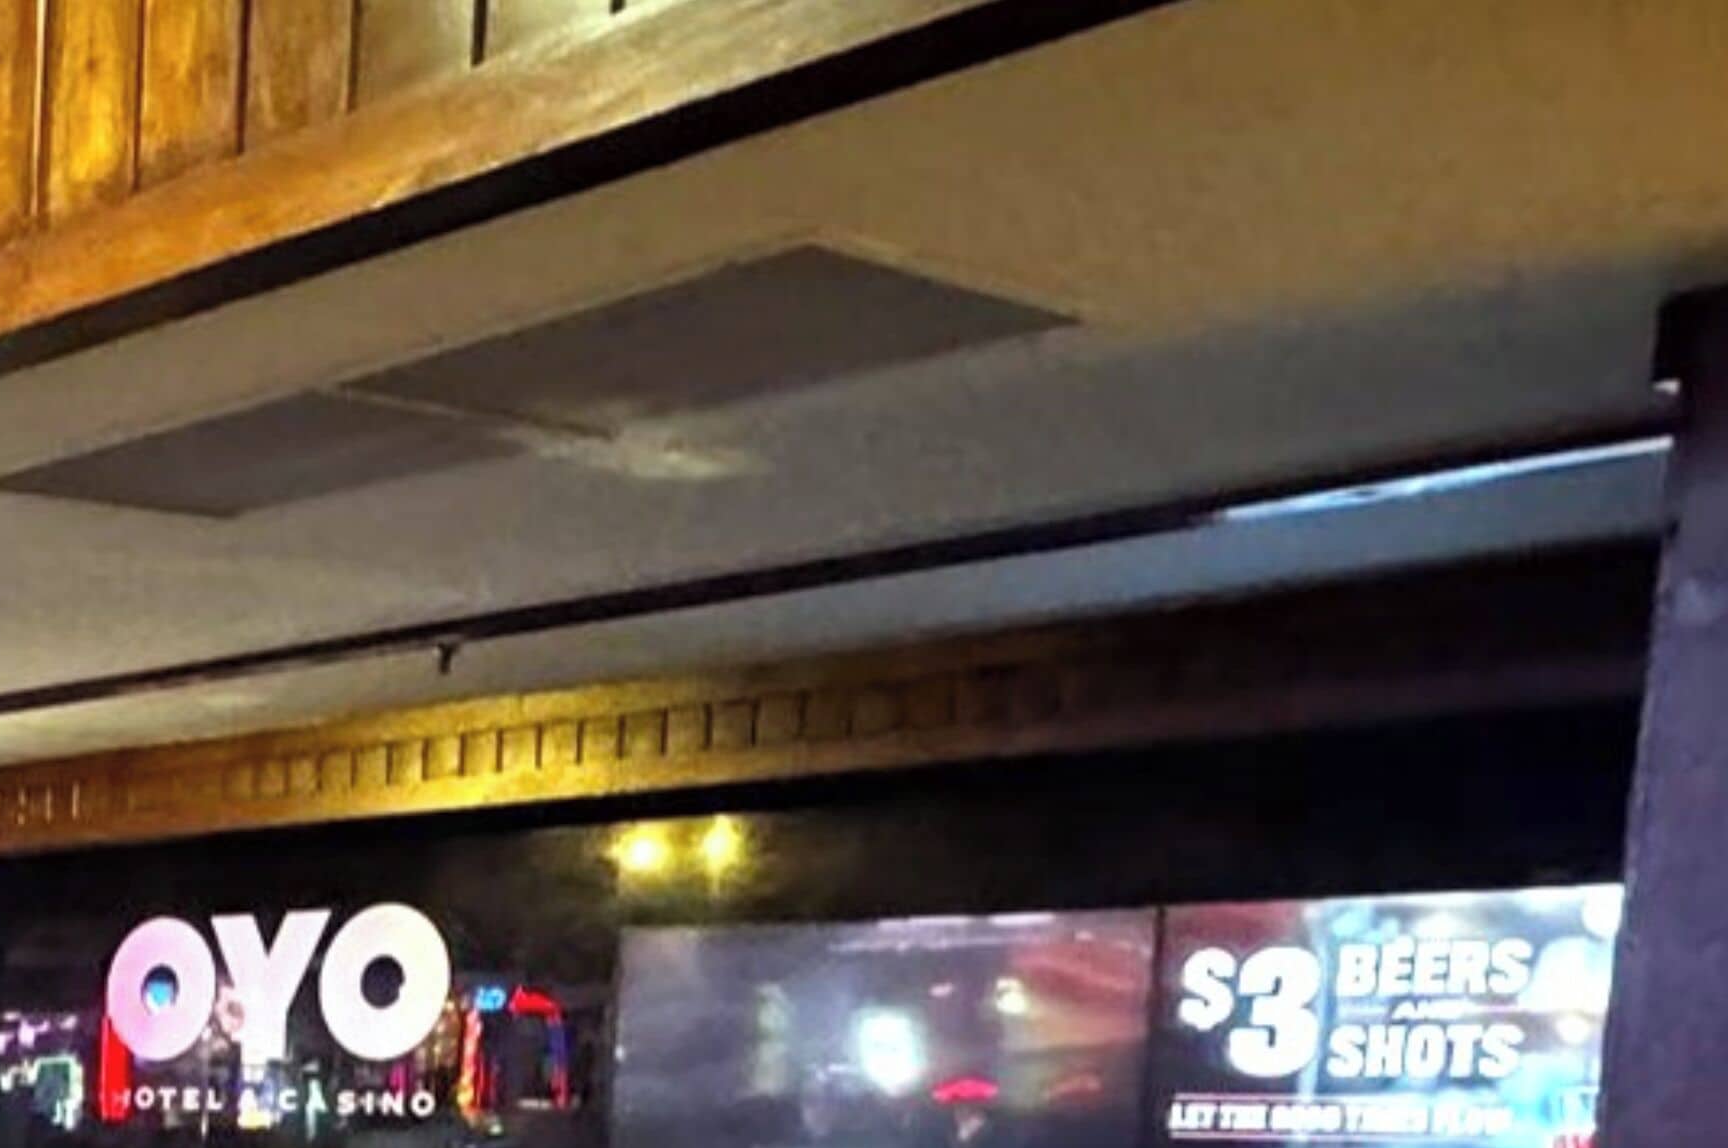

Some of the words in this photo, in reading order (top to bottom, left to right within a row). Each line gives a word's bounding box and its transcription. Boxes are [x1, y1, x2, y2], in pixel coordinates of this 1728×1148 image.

[106, 902, 452, 1062] OYO
[1336, 938, 1532, 998] BEERS
[1178, 946, 1323, 1077] $3
[1326, 1022, 1525, 1079] SHOTS
[278, 1088, 436, 1117] CASINO
